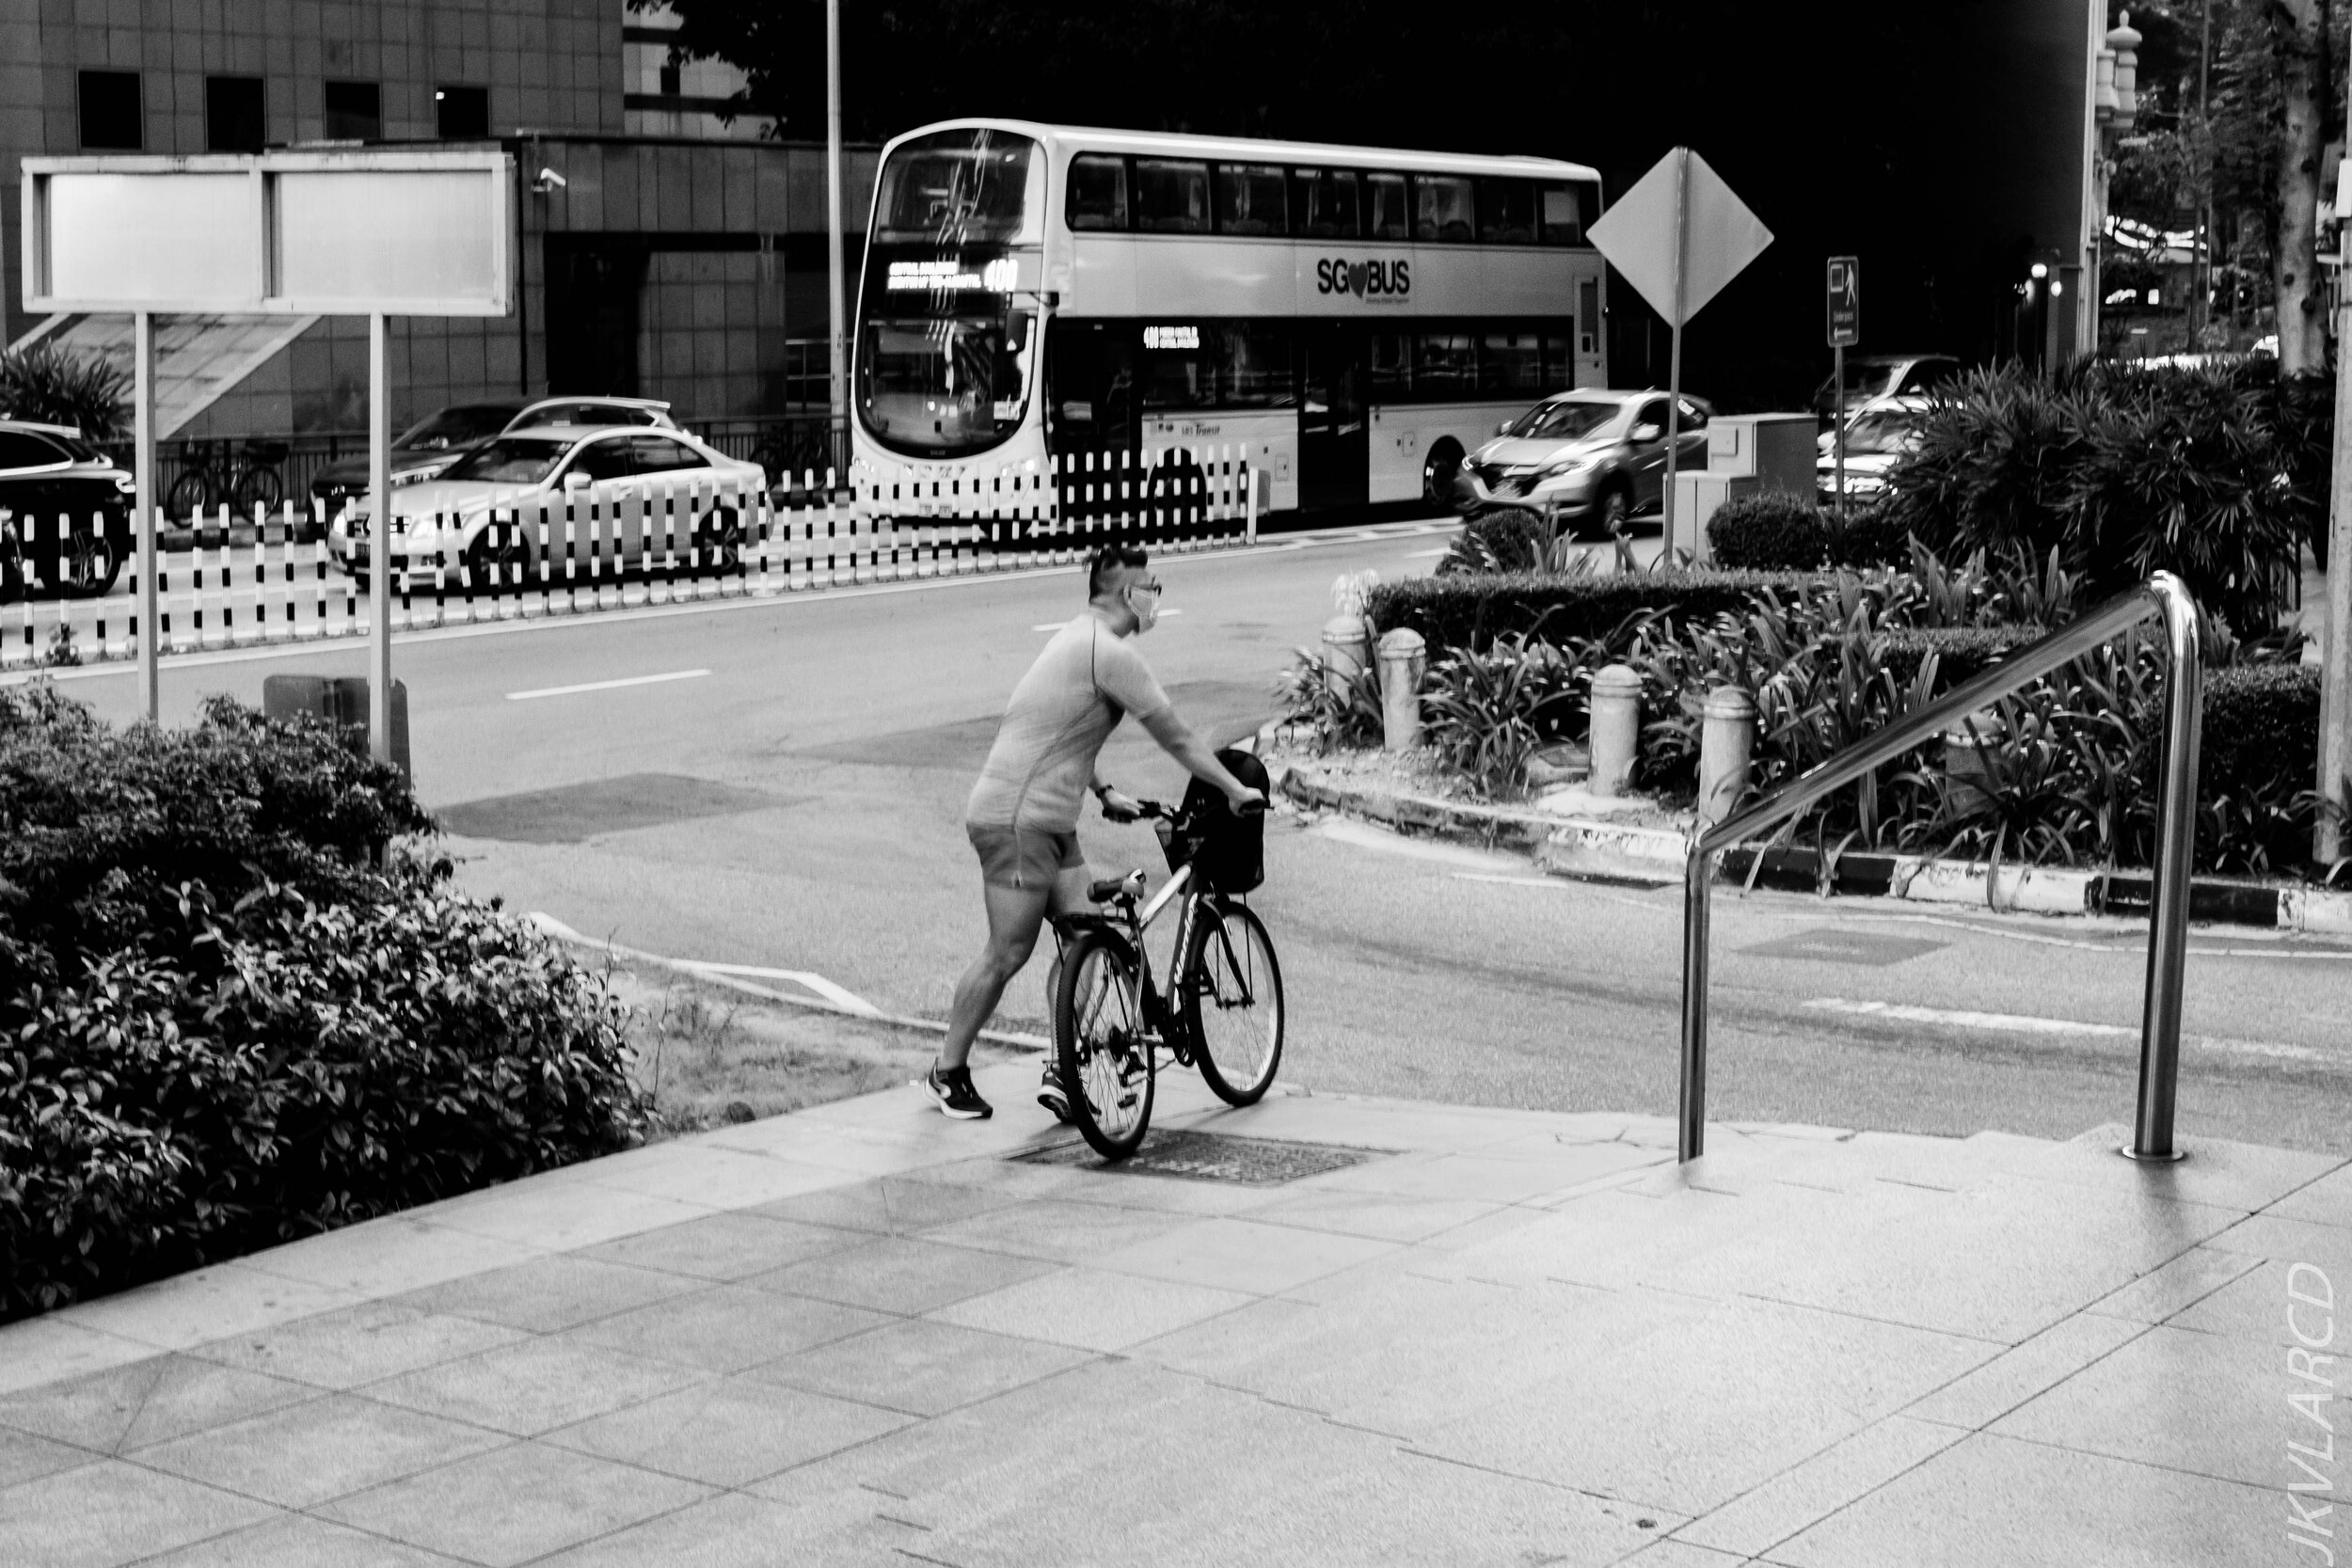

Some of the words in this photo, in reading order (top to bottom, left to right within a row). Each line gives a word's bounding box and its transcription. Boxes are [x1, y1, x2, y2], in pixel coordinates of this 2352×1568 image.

[984, 259, 1018, 292] 400
[1317, 258, 1349, 294] SG
[1367, 260, 1410, 294] BUS
[1143, 325, 1159, 349] 400
